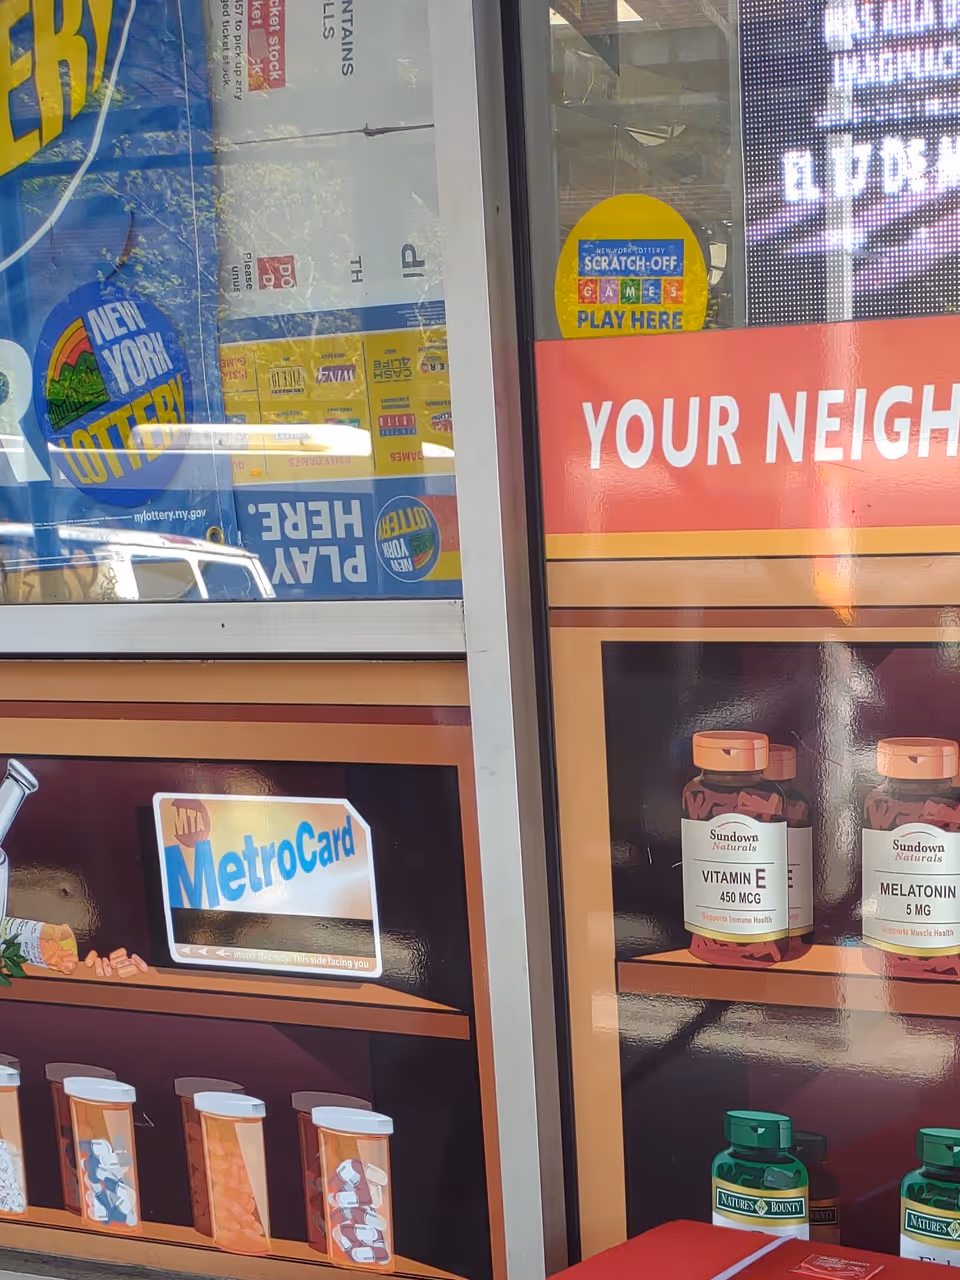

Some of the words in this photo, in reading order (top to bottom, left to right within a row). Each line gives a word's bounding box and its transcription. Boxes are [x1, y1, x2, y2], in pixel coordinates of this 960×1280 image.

[323, 0, 336, 39] LLS
[268, 36, 282, 81] stock
[781, 150, 820, 203] EL
[880, 134, 928, 196] DE
[244, 252, 254, 290] Please
[584, 255, 678, 271] SCRATCH-OFF
[583, 286, 677, 298] GAMES
[87, 300, 147, 346] NEW
[577, 310, 627, 329] PLAY
[631, 310, 684, 330] HERE
[101, 331, 174, 396] YORK
[372, 356, 412, 368] 4LIFE
[373, 368, 413, 380] CASH
[59, 373, 187, 485] LOTTERY
[581, 395, 741, 471] YOUR
[133, 508, 207, 523] nylottery.ny.gov
[247, 499, 364, 541] HERE.
[378, 506, 433, 541] LOTTERY
[381, 537, 409, 559] YORK
[271, 544, 369, 585] PLAY
[391, 559, 413, 572] NEW
[174, 808, 205, 836] MTA
[709, 828, 760, 843] Sundown
[711, 841, 758, 853] Naturals
[892, 839, 946, 854] Sundown
[164, 815, 356, 910] MetroCard
[894, 851, 943, 863] Naturals
[701, 869, 752, 886] VITAMIN
[755, 868, 767, 890] E
[719, 891, 737, 904] 450
[738, 891, 761, 905] MCG
[879, 881, 957, 899] MELATONIN
[702, 911, 729, 924] Supports
[729, 914, 752, 924] Immune
[753, 914, 773, 925] Health
[905, 902, 912, 916] 5
[914, 903, 931, 917] MG
[881, 926, 909, 937] Supports
[909, 927, 933, 938] Muscle
[933, 927, 955, 938] Health
[293, 954, 309, 964] This
[309, 956, 327, 966] side
[327, 957, 353, 969] facing
[353, 959, 369, 969] you
[720, 1192, 755, 1212] NATURE'S
[770, 1201, 802, 1214] BOUNTY
[909, 1214, 947, 1234] NATURE'S
